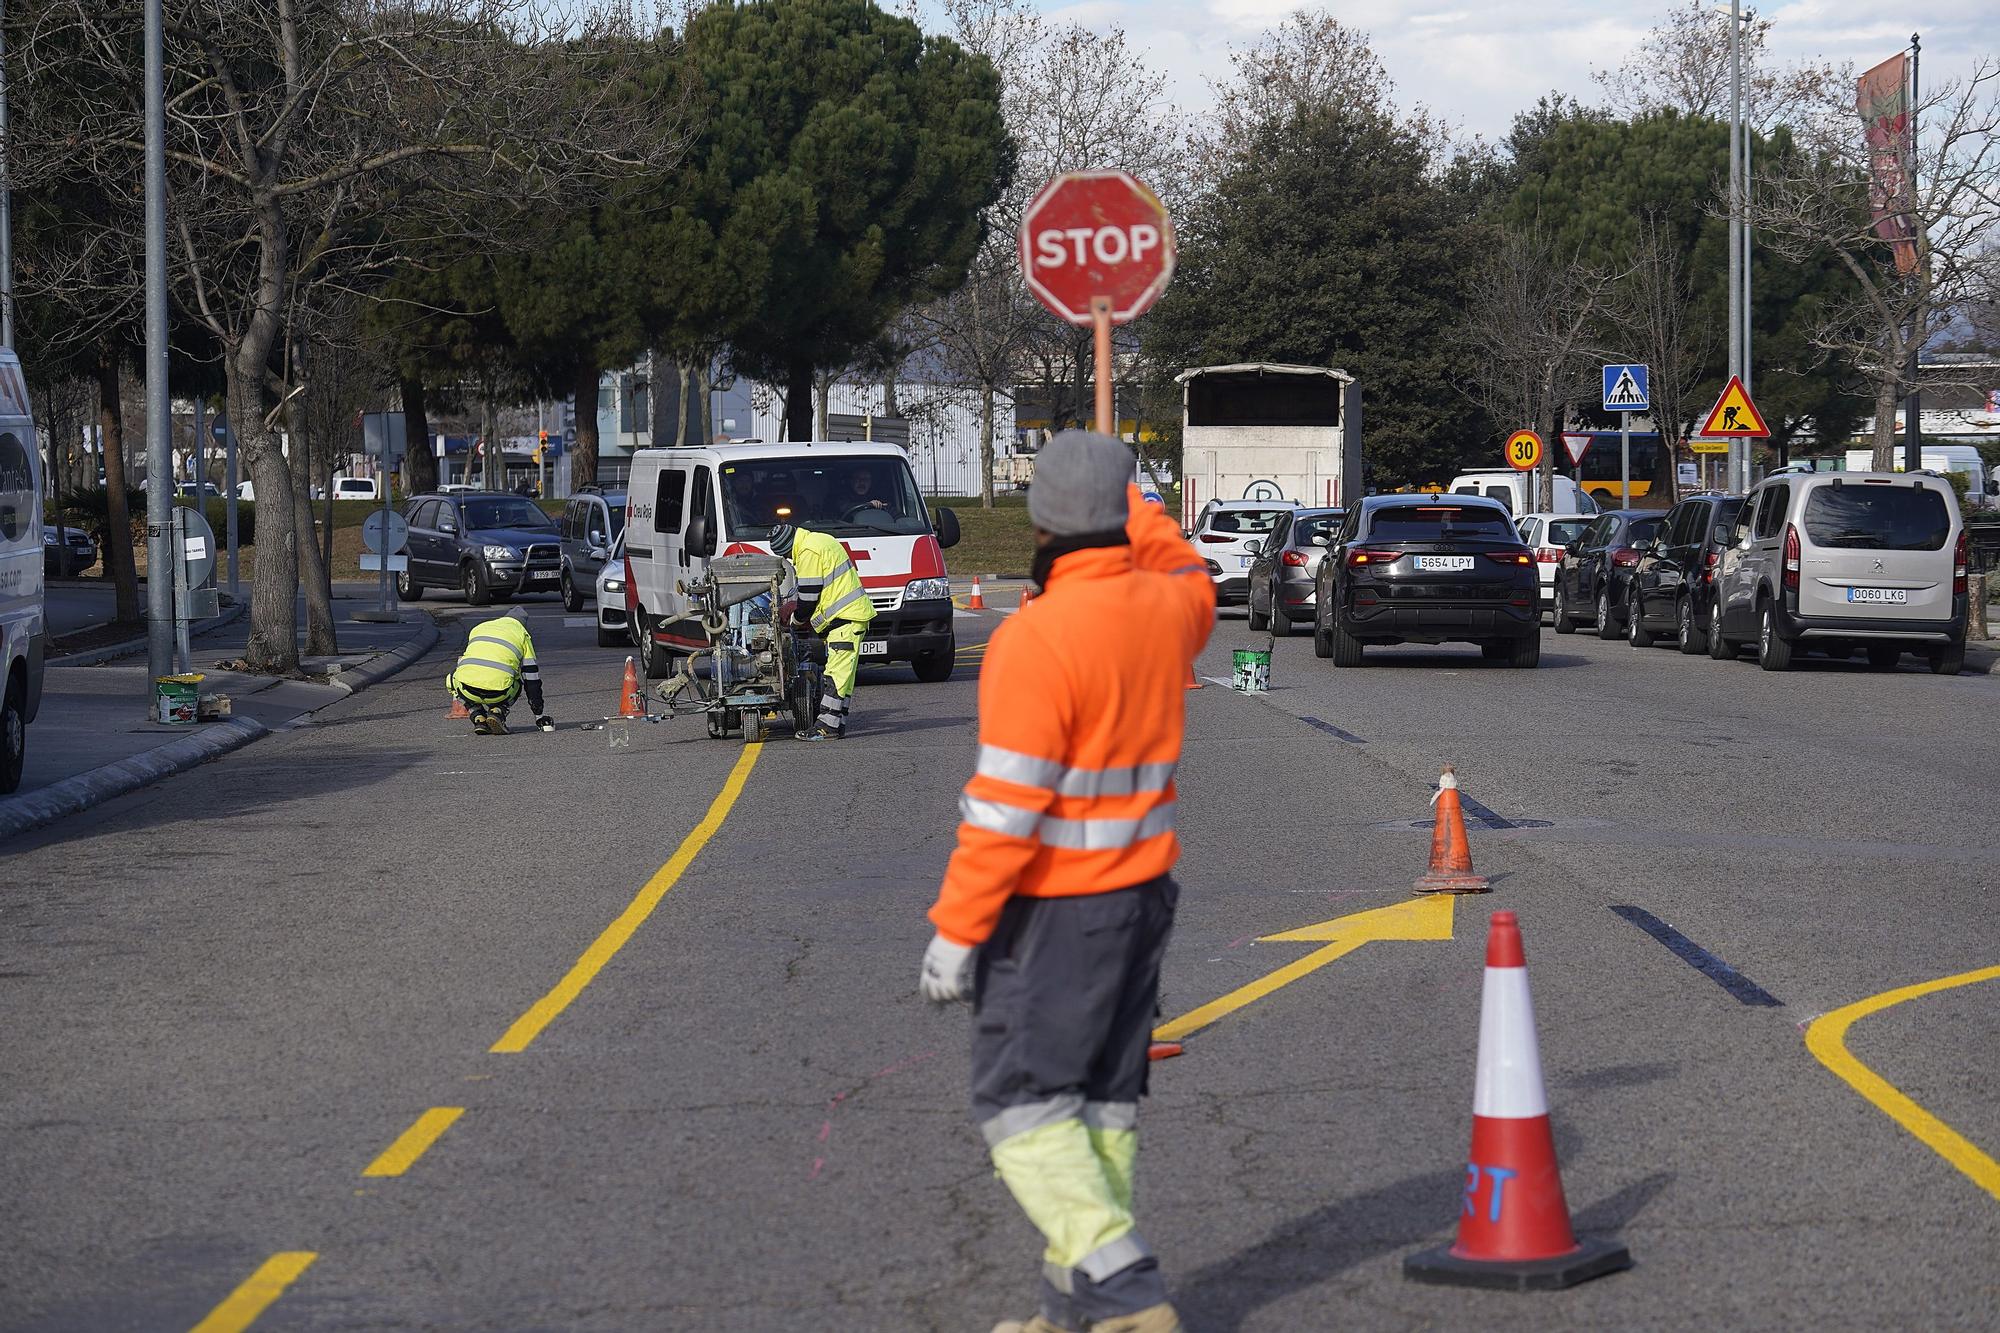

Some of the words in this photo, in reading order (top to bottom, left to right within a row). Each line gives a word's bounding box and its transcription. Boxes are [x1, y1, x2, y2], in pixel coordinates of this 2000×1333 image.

[1036, 224, 1159, 268] STOP
[1515, 441, 1533, 460] 30
[1421, 557, 1448, 568] 5654
[1451, 557, 1472, 568] LPY
[1854, 589, 1881, 600] 0060
[1884, 590, 1904, 600] LKG
[862, 642, 883, 654] DPL
